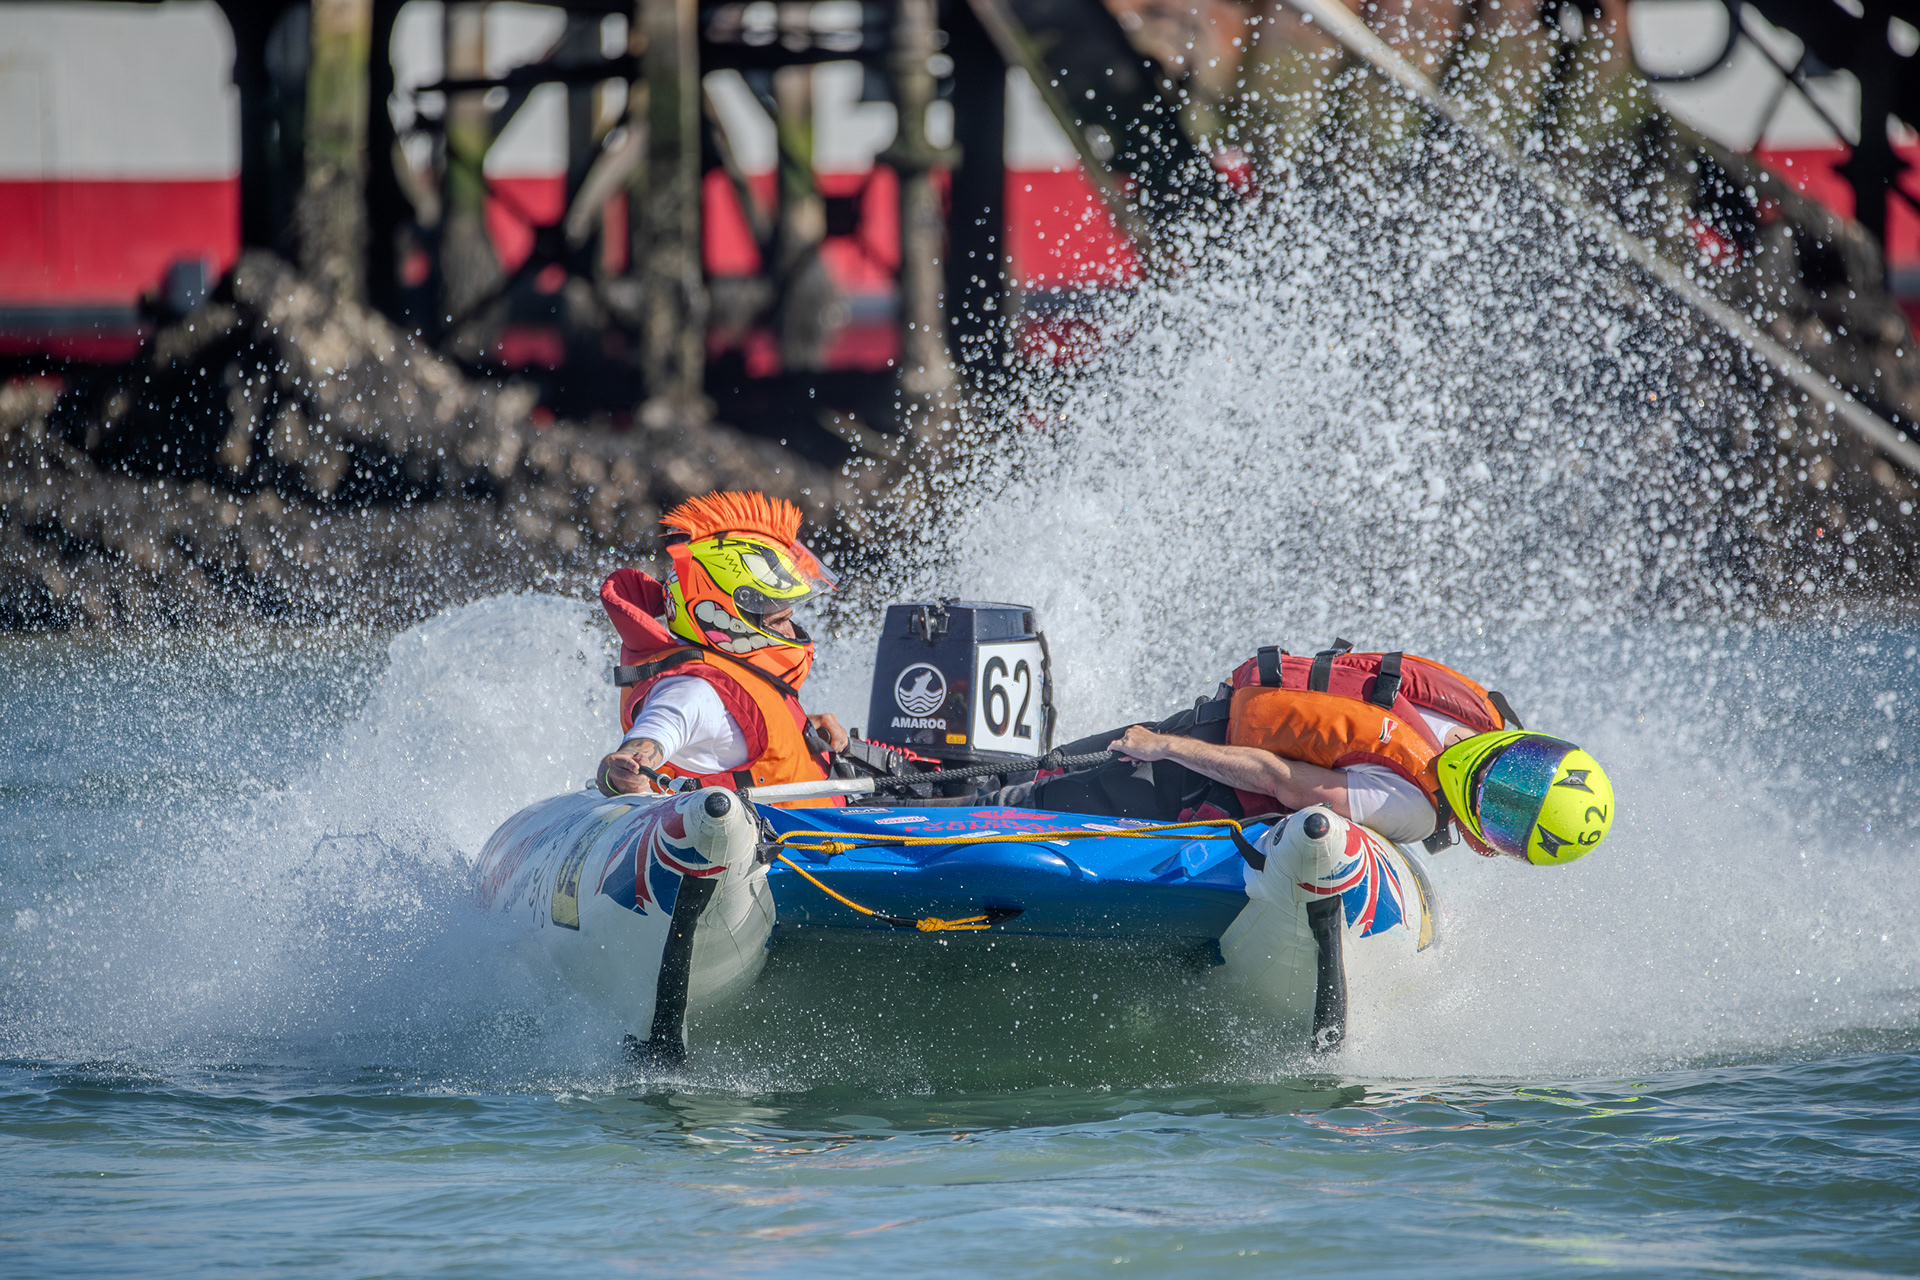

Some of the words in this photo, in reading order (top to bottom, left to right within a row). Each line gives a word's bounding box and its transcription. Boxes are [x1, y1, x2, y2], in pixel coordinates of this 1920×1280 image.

[982, 655, 1032, 740] 62
[891, 717, 947, 731] AMAROQ
[1577, 803, 1608, 847] 62
